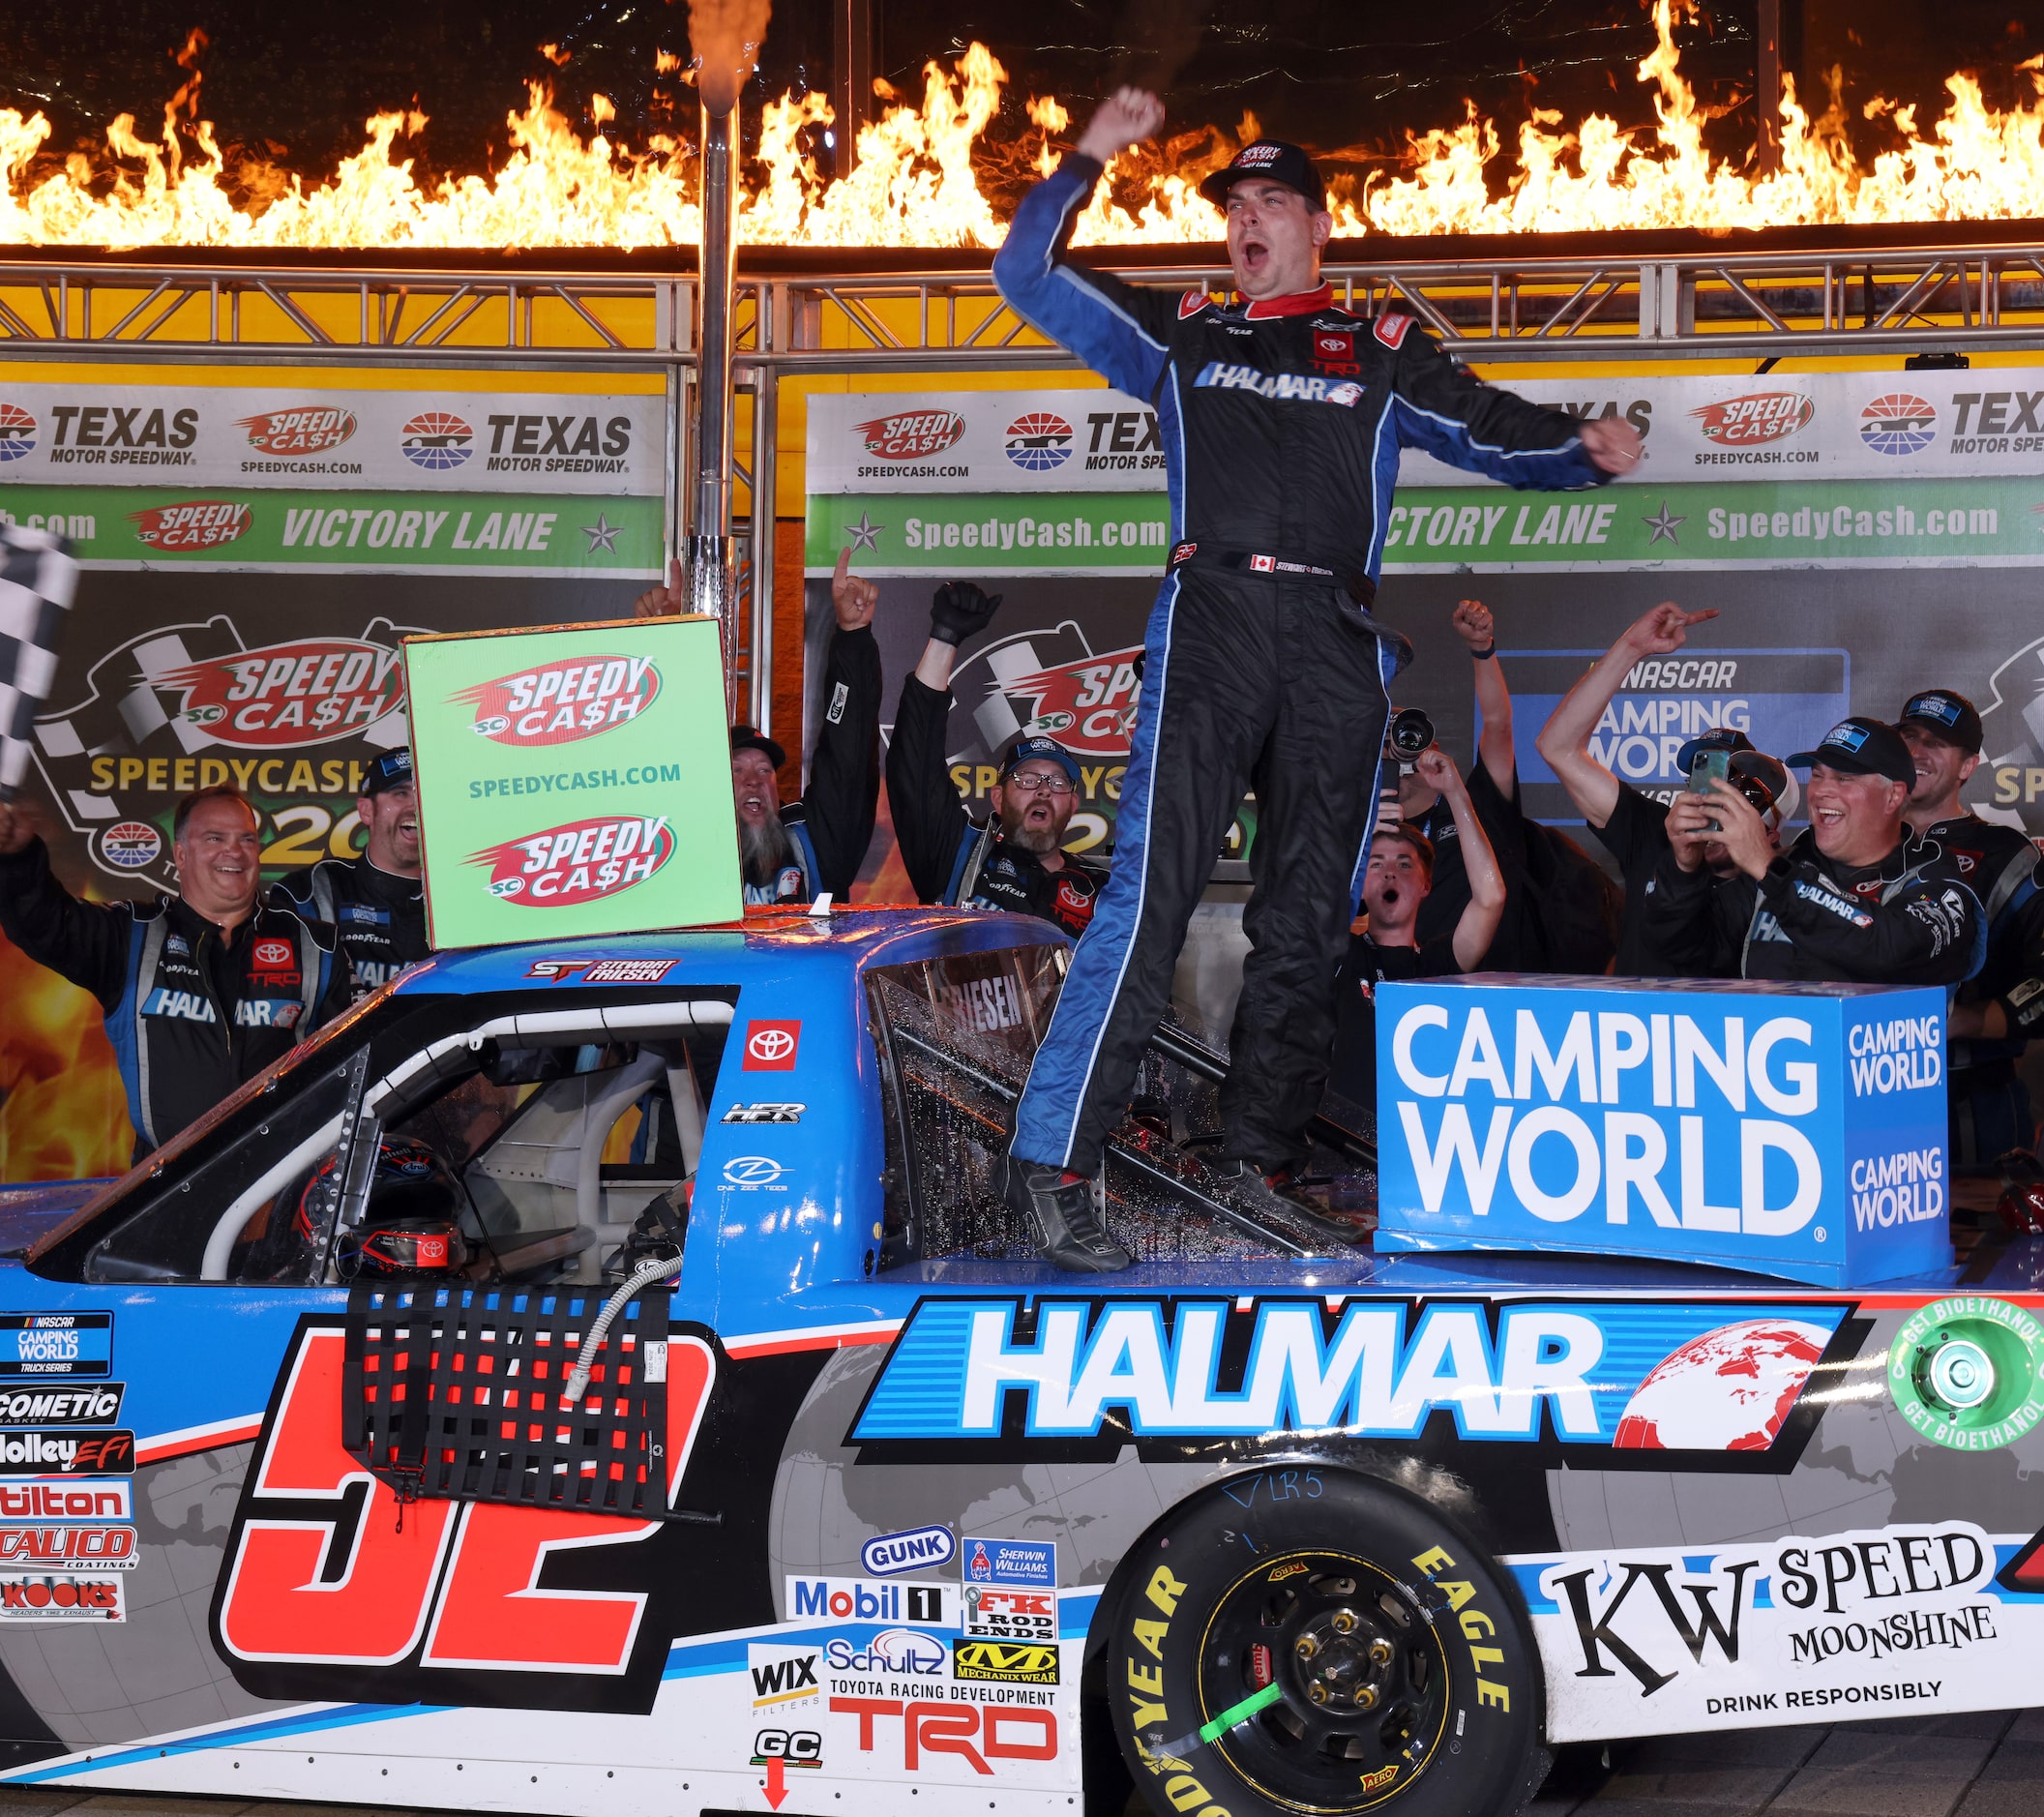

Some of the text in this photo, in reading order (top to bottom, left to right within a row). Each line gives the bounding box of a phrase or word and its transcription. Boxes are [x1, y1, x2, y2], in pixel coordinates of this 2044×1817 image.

[1209, 363, 1327, 402] HALMAR
[268, 405, 353, 435] SPEEDY
[882, 411, 958, 440] SPEEDY
[1721, 394, 1812, 424] SPEEDY
[1951, 391, 2044, 435] TEX
[51, 405, 199, 448] TEXAS
[487, 415, 632, 458] TEXAS
[1086, 412, 1164, 453] TEX
[50, 449, 193, 465] MOTOR SPEEDWAY
[1085, 456, 1137, 470] MOTOR
[1695, 451, 1820, 464] SPEEDYCASH.COM
[1950, 437, 2009, 455] MOTOR
[241, 461, 362, 475] SPEEDYCASH.COM
[487, 458, 626, 473] MOTOR SPEEDWAY
[857, 465, 968, 478] SPEEDYCASH.COM
[161, 502, 250, 531] SPEEDY
[281, 509, 558, 552] VICTORY LANE
[1385, 503, 1617, 548] CTORY LANE
[1707, 503, 1999, 542] SpeedyCash.com
[905, 518, 1166, 551] SpeedyCash.com
[234, 650, 399, 702] SPEEDY
[501, 656, 654, 712] SPEEDY
[1620, 661, 1737, 689] NASCAR
[515, 695, 642, 735] CA$H
[1592, 700, 1750, 734] AMPING
[1585, 735, 1691, 779] WOR
[91, 756, 370, 793] SPEEDYCASH
[469, 763, 681, 798] SPEEDYCASH.COM
[518, 816, 668, 874] SPEEDY
[529, 854, 658, 898] CA$H
[1796, 883, 1854, 921] HALMAR
[247, 971, 302, 987] TRD
[585, 968, 666, 981] FRIESEN
[596, 960, 677, 970] STEWART
[939, 974, 1022, 1032] FRIESEN
[1849, 1014, 1940, 1063] CAMPING
[1392, 1003, 1819, 1117] CAMPING
[1850, 1048, 1940, 1098] WORLD
[721, 1102, 807, 1122] HFR
[1396, 1100, 1822, 1237] WORLD
[1851, 1147, 1942, 1198] CAMPING
[1851, 1181, 1942, 1234] WORLD
[18, 1331, 78, 1346] CAMPING
[36, 1317, 74, 1328] NASCAR
[1905, 1297, 2041, 1346] GET BIOETHANOL
[18, 1344, 78, 1360] WORLD
[21, 1363, 73, 1372] TRUCK SERIES
[960, 1310, 1603, 1433] HALMAR
[1904, 1399, 2044, 1448] GET BIOETHANOL
[71, 1436, 132, 1469] EFI
[0, 1487, 122, 1516] tilton
[221, 1326, 717, 1676] 52
[871, 1534, 944, 1567] GUNK
[995, 1560, 1047, 1573] WILLIAMS
[997, 1548, 1046, 1562] SHERWIN
[1275, 1562, 1301, 1577] AERO
[1778, 1533, 1983, 1614] SPEED
[1, 1581, 117, 1608] KOOKS
[794, 1581, 899, 1620] Mobil
[978, 1592, 1052, 1616] FK
[968, 1624, 1053, 1640] ENDS
[988, 1614, 1053, 1627] ROD
[1411, 1545, 1510, 1713] EAGLE
[1552, 1560, 1760, 1698] KW
[1789, 1605, 1998, 1665] MOONSHINE
[828, 1640, 945, 1675] Schultz
[957, 1665, 1057, 1683] MECHANIX WEAR
[752, 1654, 818, 1697] WIX
[753, 1697, 819, 1717] FILTERS
[830, 1680, 1055, 1706] TOYOTA RACING DEVELOPMENT
[1706, 1681, 1942, 1715] DRINK RESPONSIBLY
[755, 1729, 822, 1759] GC
[829, 1697, 1058, 1775] TRD
[1366, 1770, 1394, 1789] AERO
